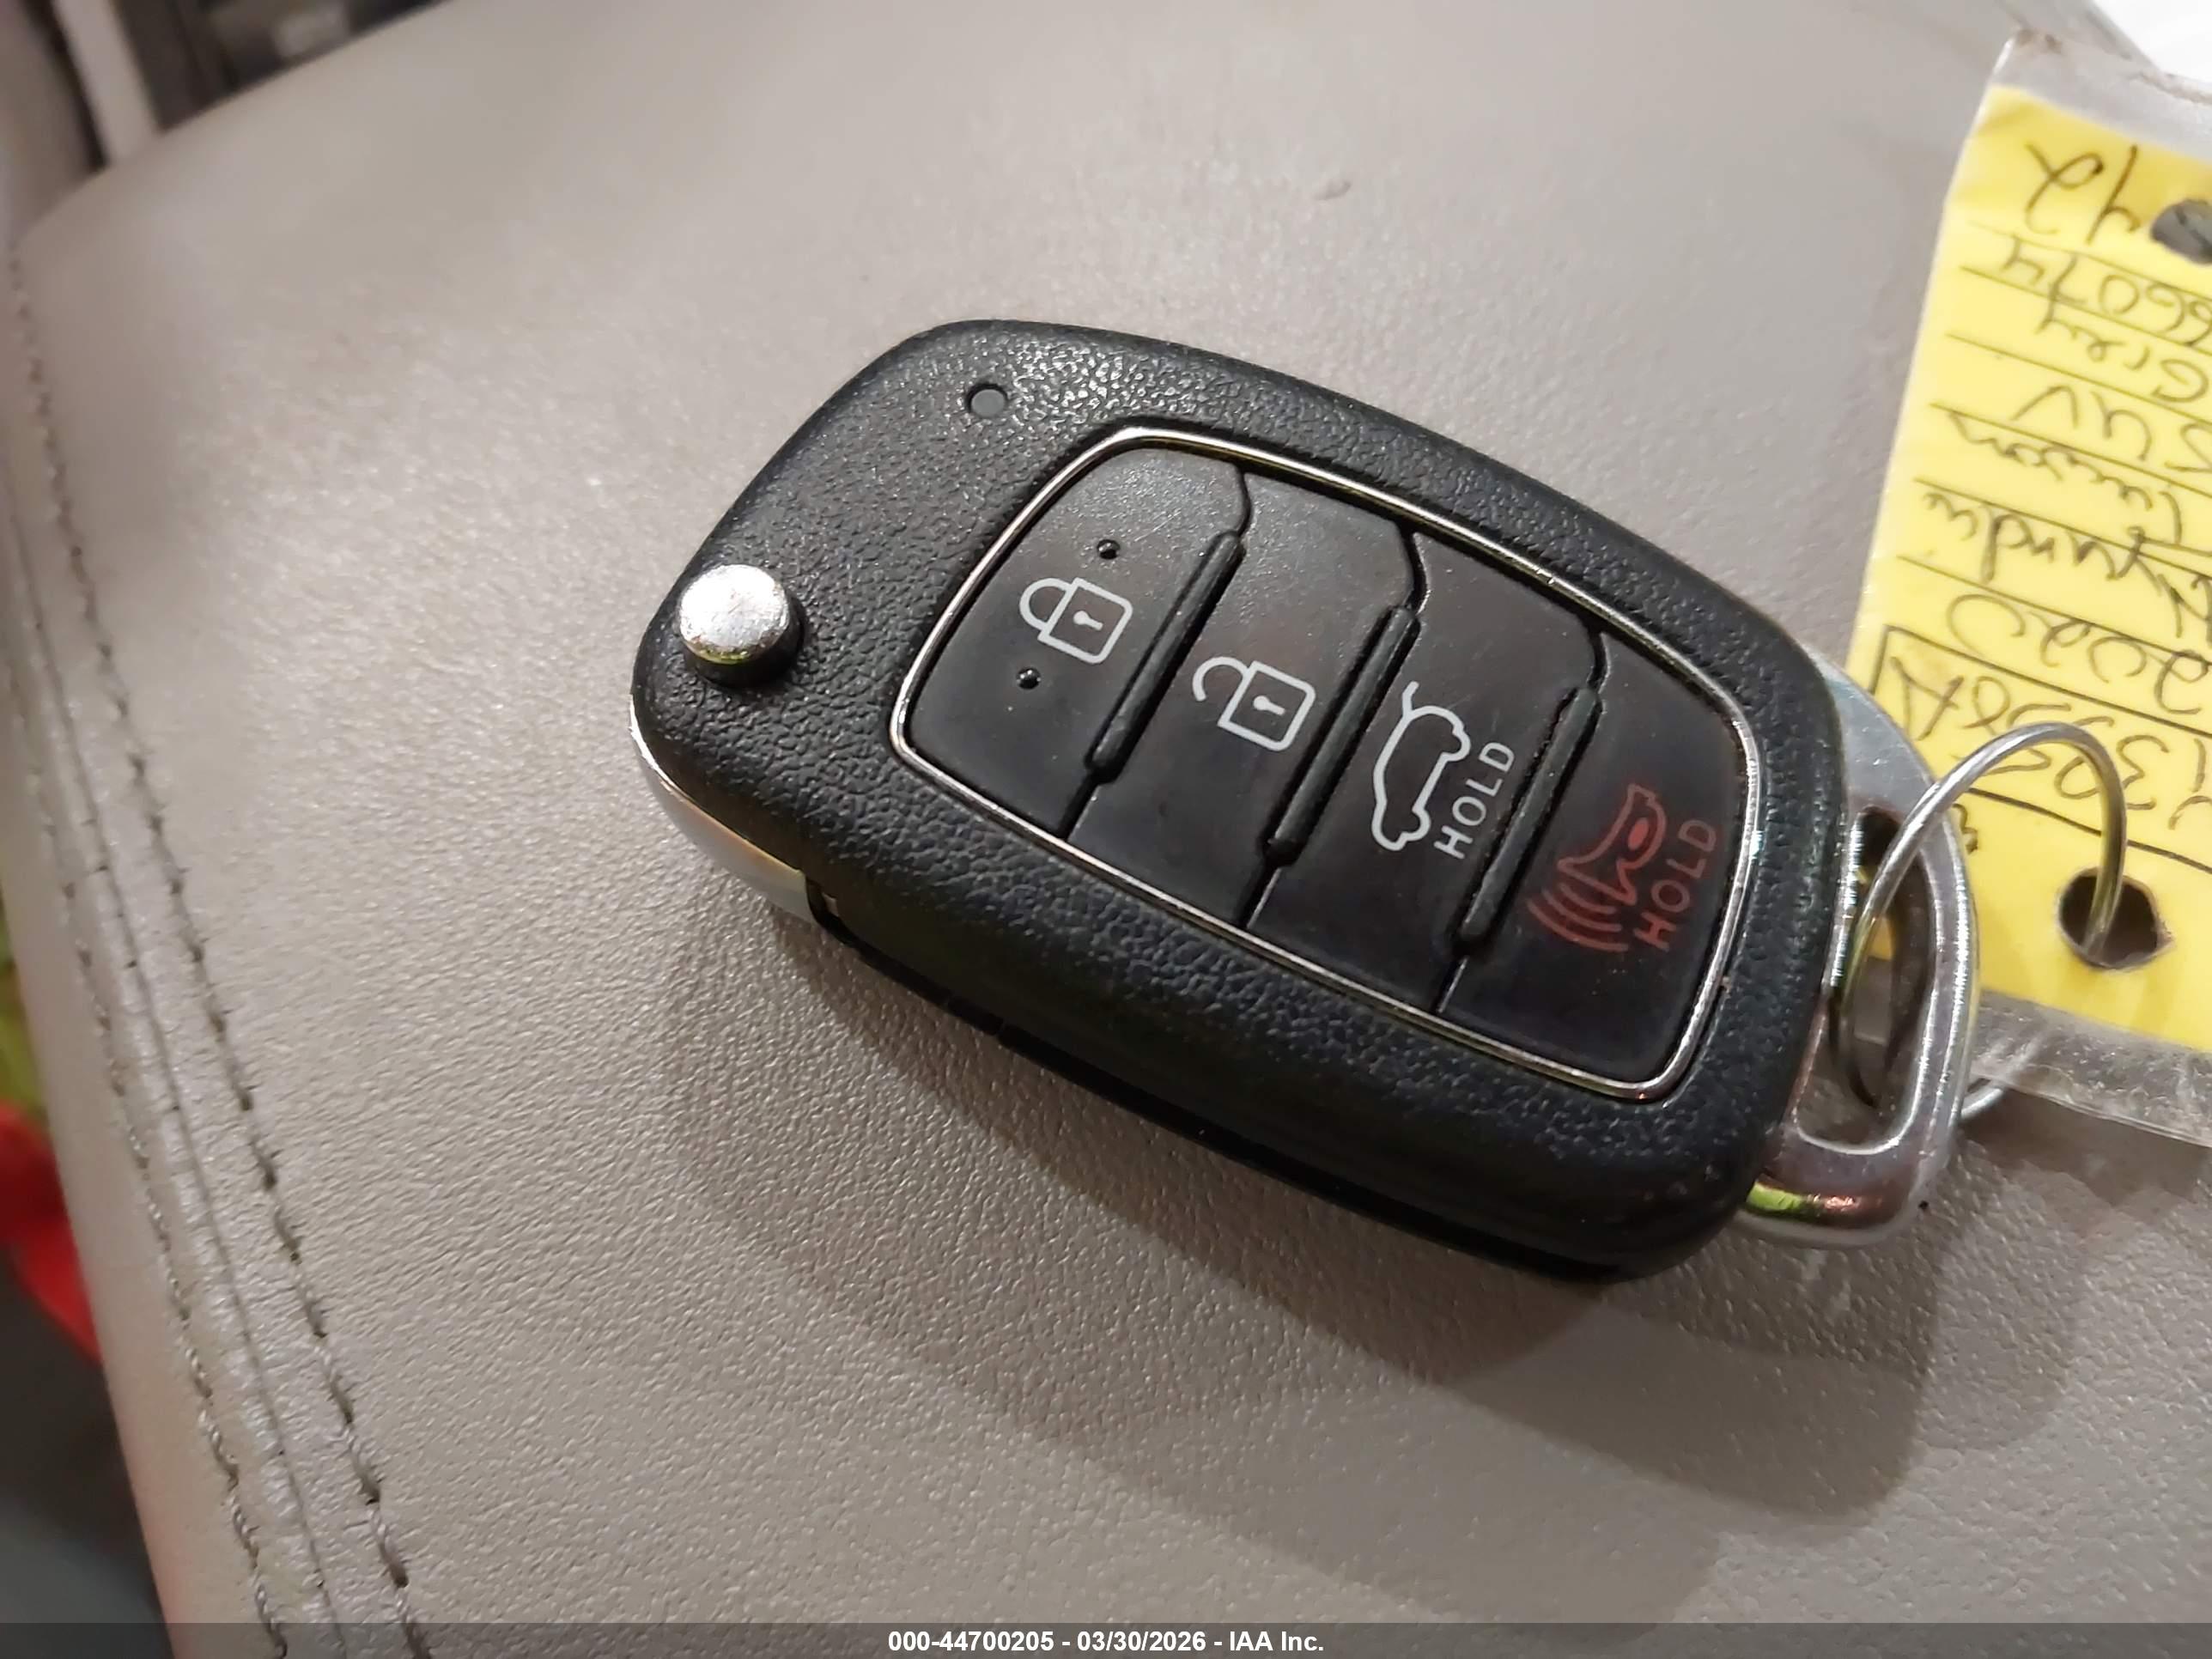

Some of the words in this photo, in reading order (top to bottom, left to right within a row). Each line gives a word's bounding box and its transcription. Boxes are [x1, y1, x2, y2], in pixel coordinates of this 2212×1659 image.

[2034, 296, 2209, 404] Grey
[2011, 386, 2212, 473] SUV
[1947, 593, 2210, 715] 2020
[1433, 741, 1516, 860] HOLD
[1632, 818, 1717, 952] HOLD
